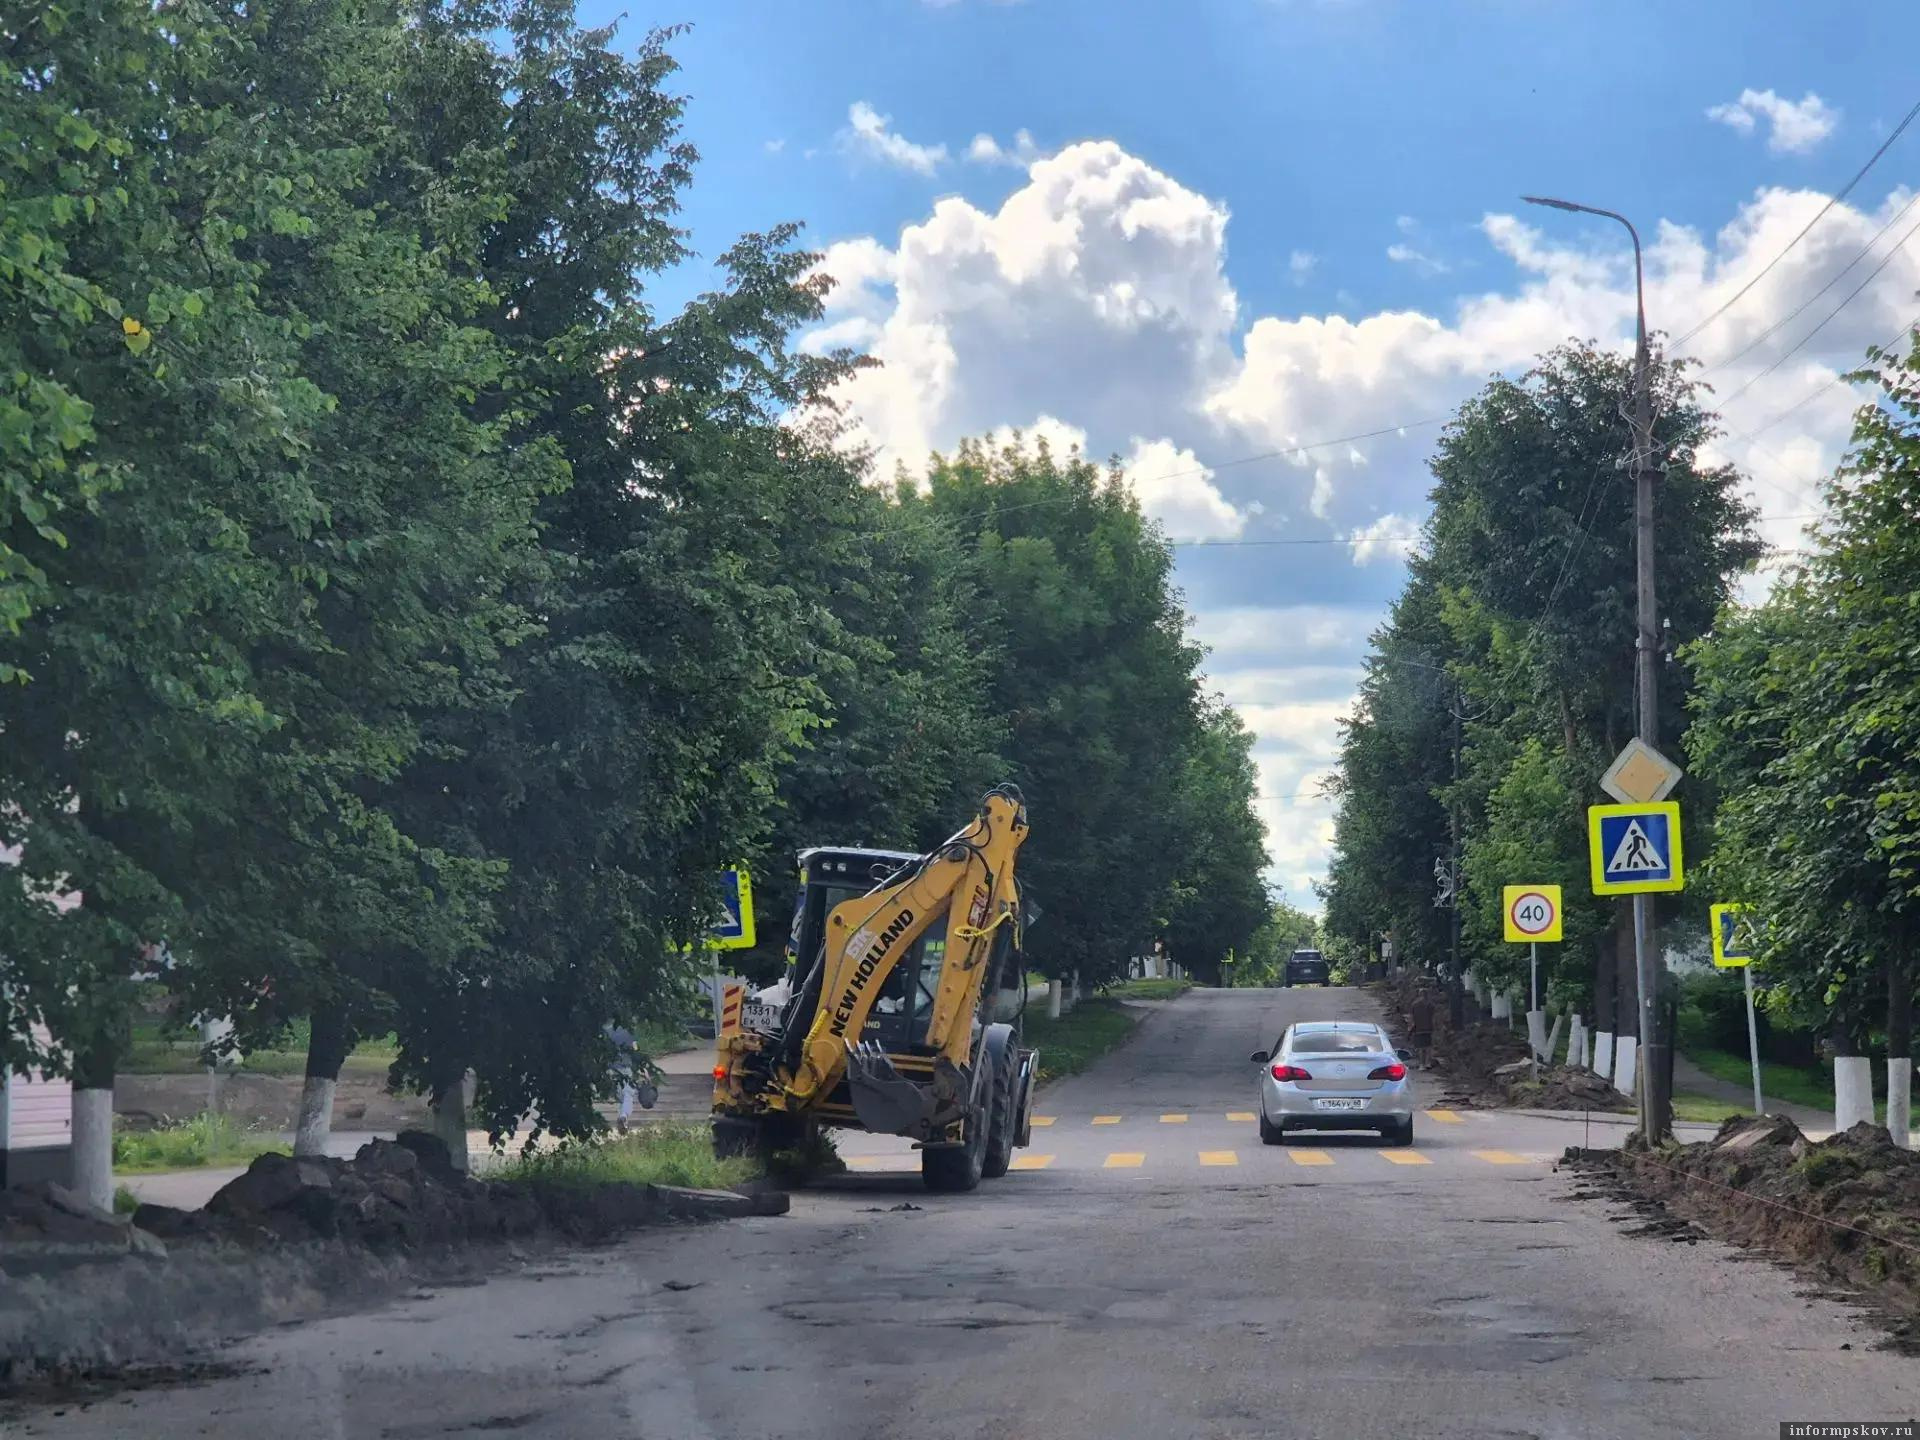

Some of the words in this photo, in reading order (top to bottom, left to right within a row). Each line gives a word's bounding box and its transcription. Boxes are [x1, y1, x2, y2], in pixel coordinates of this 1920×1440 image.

[1520, 904, 1544, 922] 40
[829, 988, 858, 1039] NEW
[850, 908, 915, 990] HOLLAND
[747, 1005, 770, 1016] 1331
